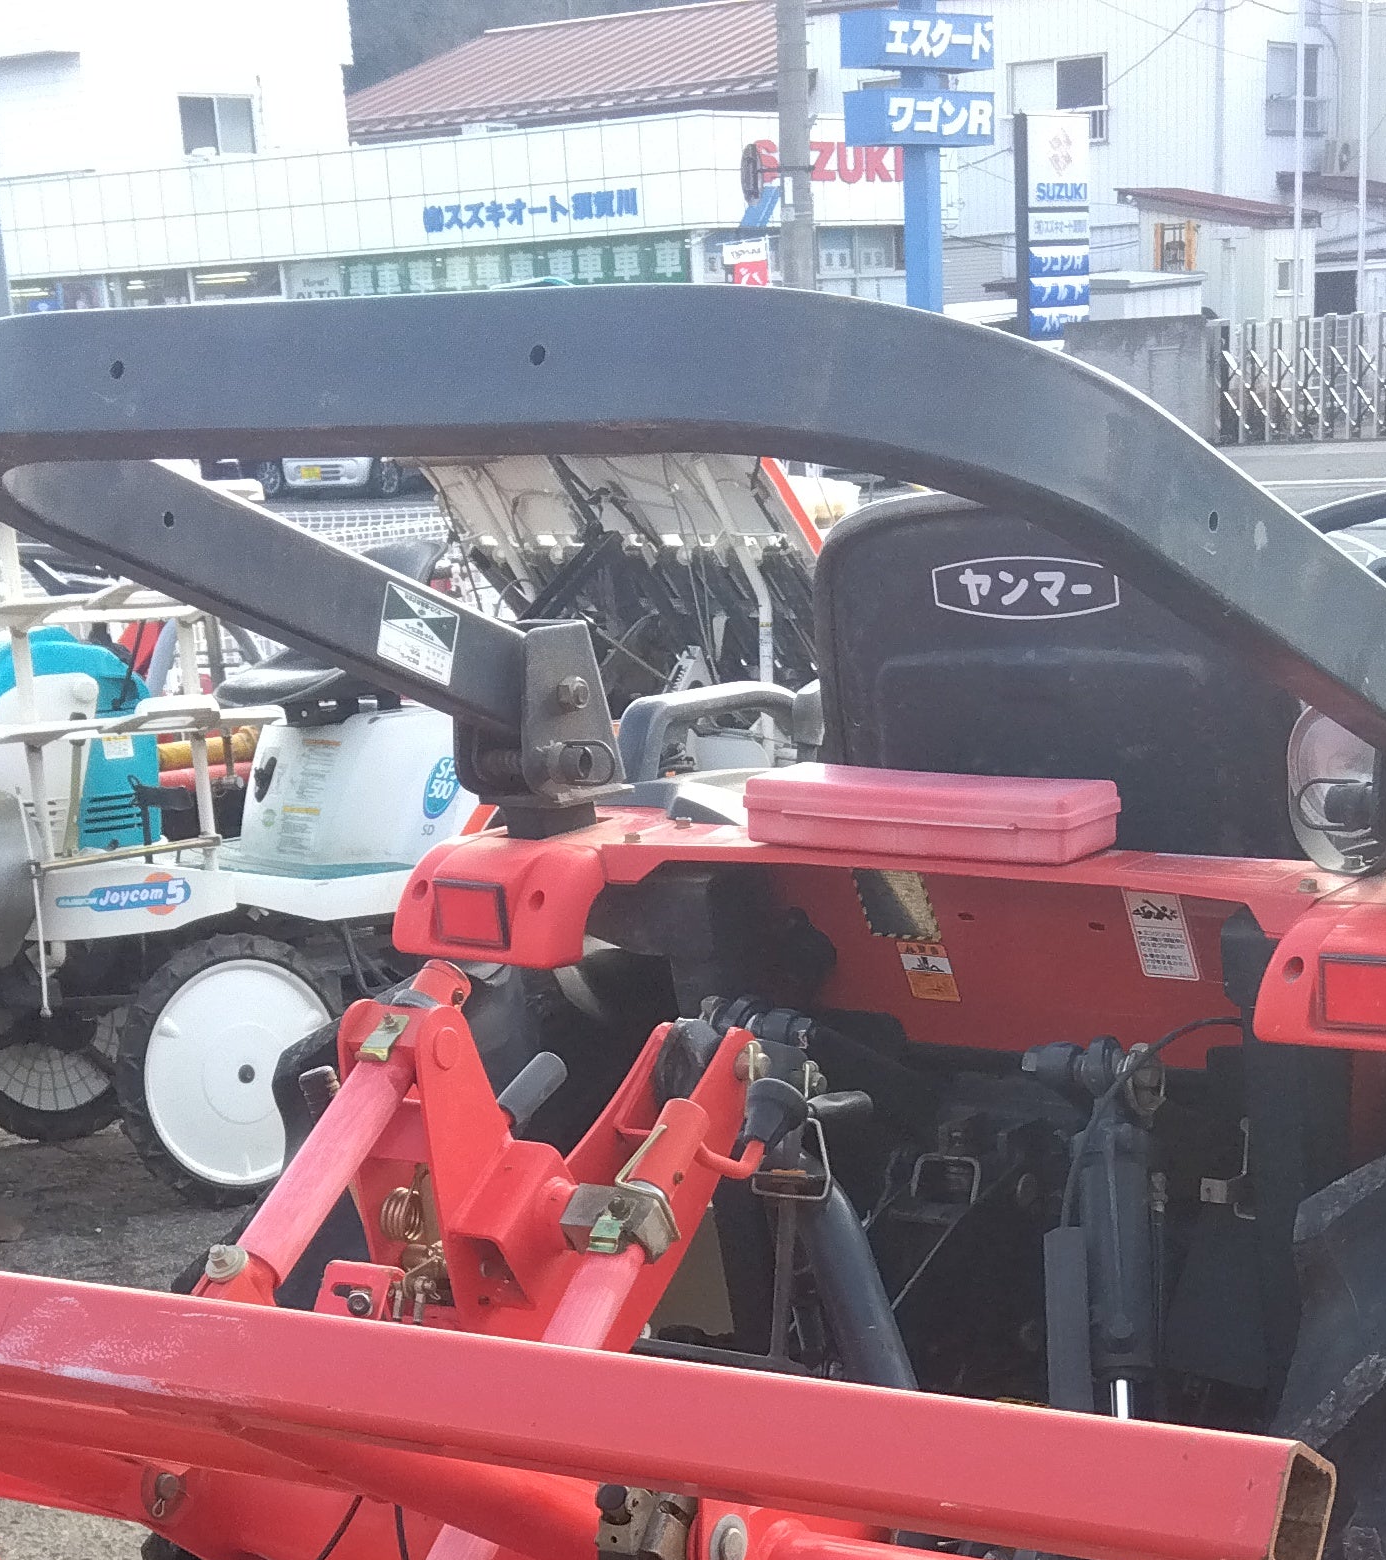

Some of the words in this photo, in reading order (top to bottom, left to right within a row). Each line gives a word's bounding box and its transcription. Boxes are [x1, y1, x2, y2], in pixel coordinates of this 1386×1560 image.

[885, 19, 994, 60] エスクード
[888, 96, 993, 136] ワゴンR
[754, 139, 904, 184] SZUKI
[1036, 182, 1088, 200] SUZUKI
[959, 568, 1092, 606] ヤンマー
[428, 778, 454, 800] 500
[421, 823, 435, 836] SD
[99, 888, 164, 907] Joycom
[166, 880, 186, 905] 5
